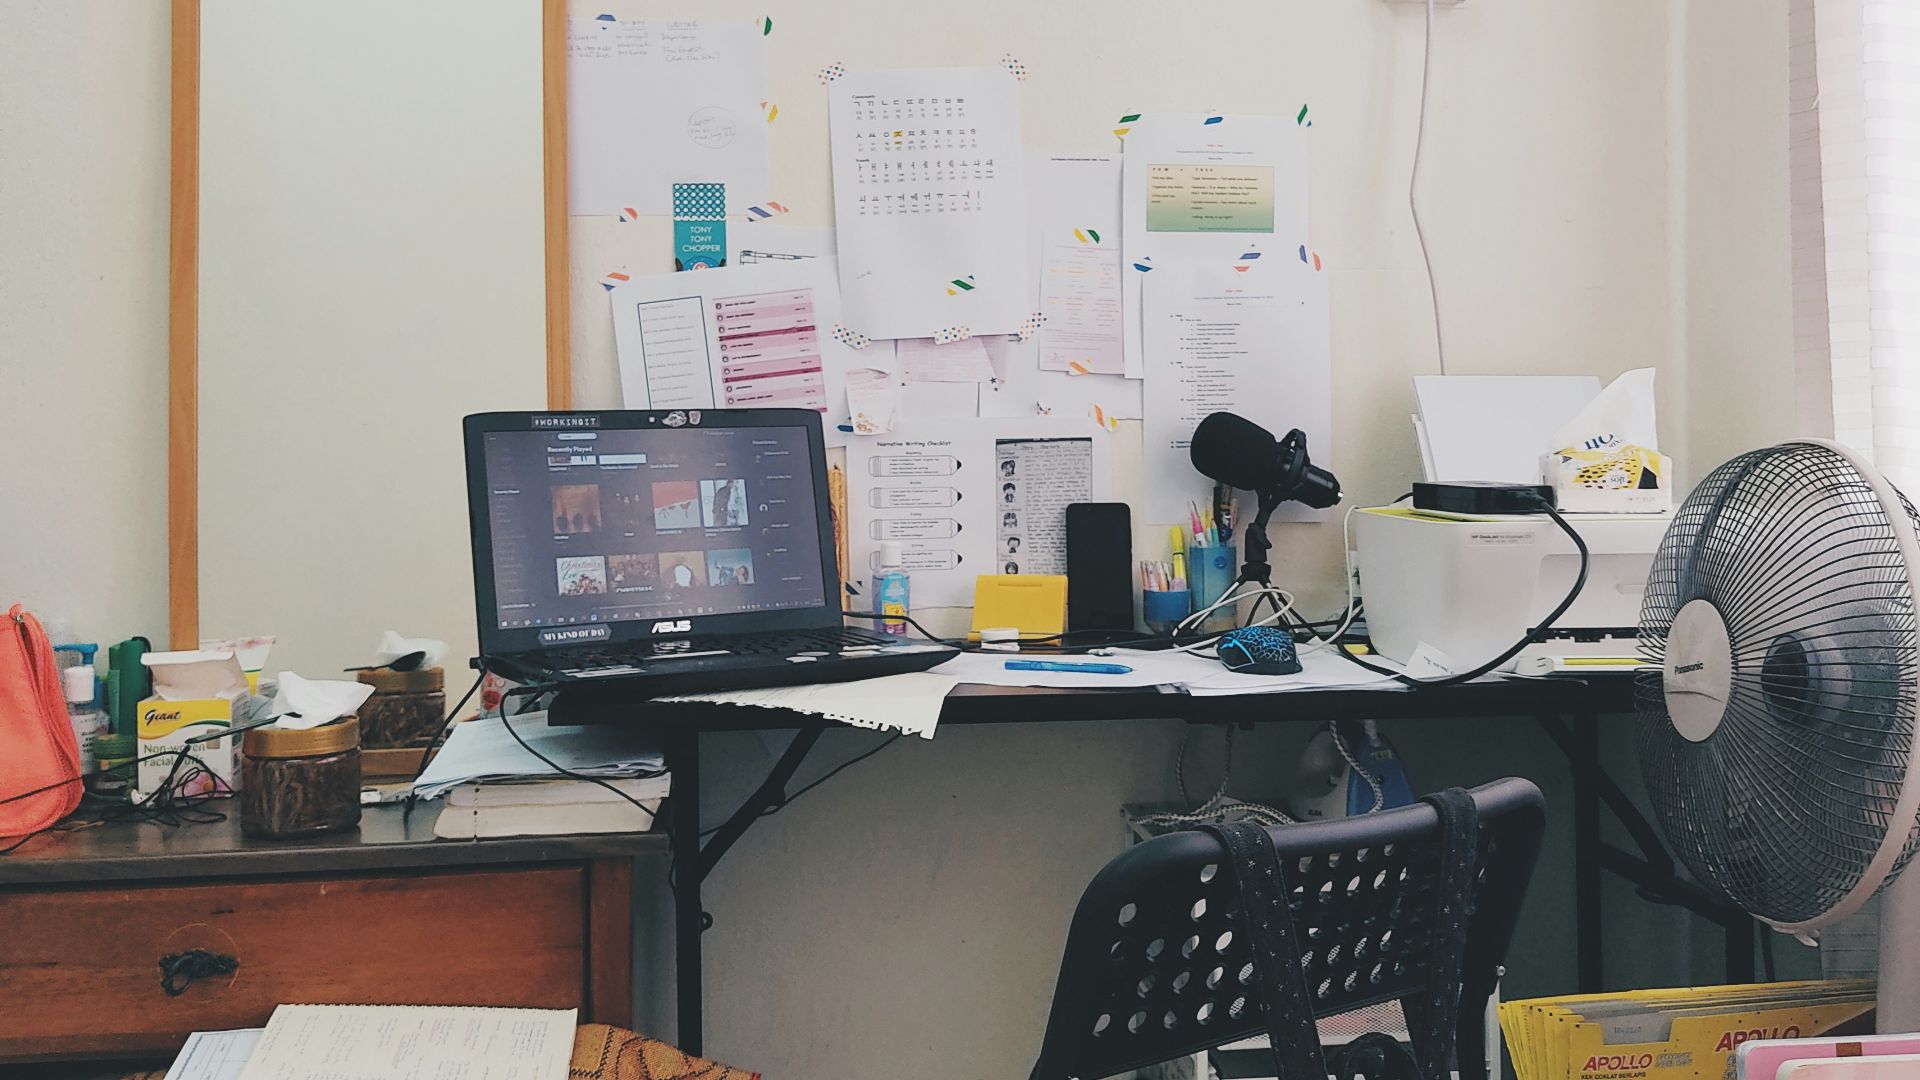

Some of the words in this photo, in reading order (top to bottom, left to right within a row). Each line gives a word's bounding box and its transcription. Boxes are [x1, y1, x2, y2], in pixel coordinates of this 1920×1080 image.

[690, 235, 712, 243] TONY
[682, 244, 721, 252] CHOPPER
[547, 446, 573, 454] Recently
[652, 620, 692, 634] ASUS
[1582, 1054, 1653, 1071] APOLLO
